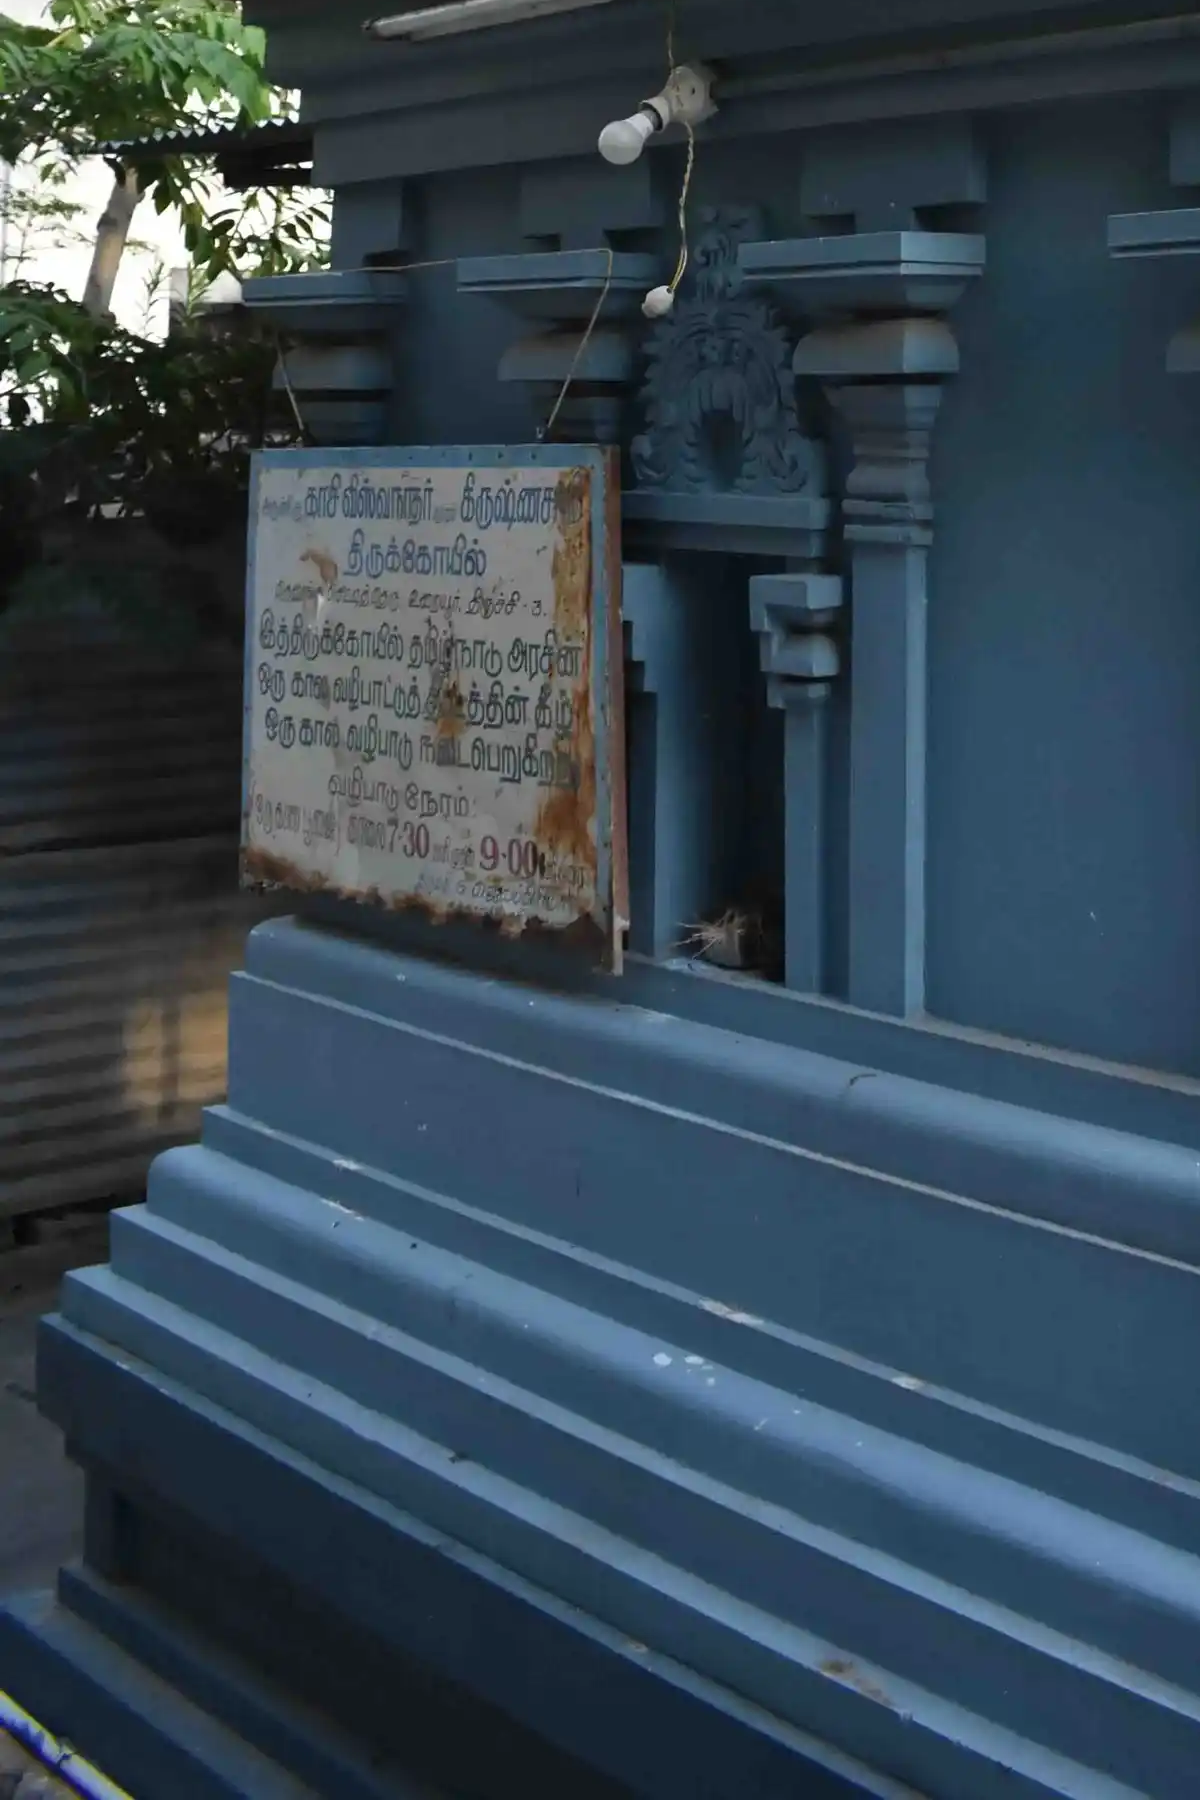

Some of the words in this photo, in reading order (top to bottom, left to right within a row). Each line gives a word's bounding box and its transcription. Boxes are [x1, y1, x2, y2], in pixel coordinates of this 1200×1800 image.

[305, 472, 341, 520] காசி
[343, 528, 486, 579] திருக்கோயில்
[464, 586, 520, 619] திருச்சி
[260, 608, 403, 661] இத்திருக்கோயில்
[407, 624, 503, 678] தமிழ்நாடு
[508, 629, 582, 681] அரசின்
[258, 662, 285, 702] ஒரு
[334, 666, 420, 720] வழிபாட்டுத்
[265, 707, 296, 749] ஒரு
[347, 713, 413, 770] வழிபாடு
[328, 764, 398, 812] வழிபாடு
